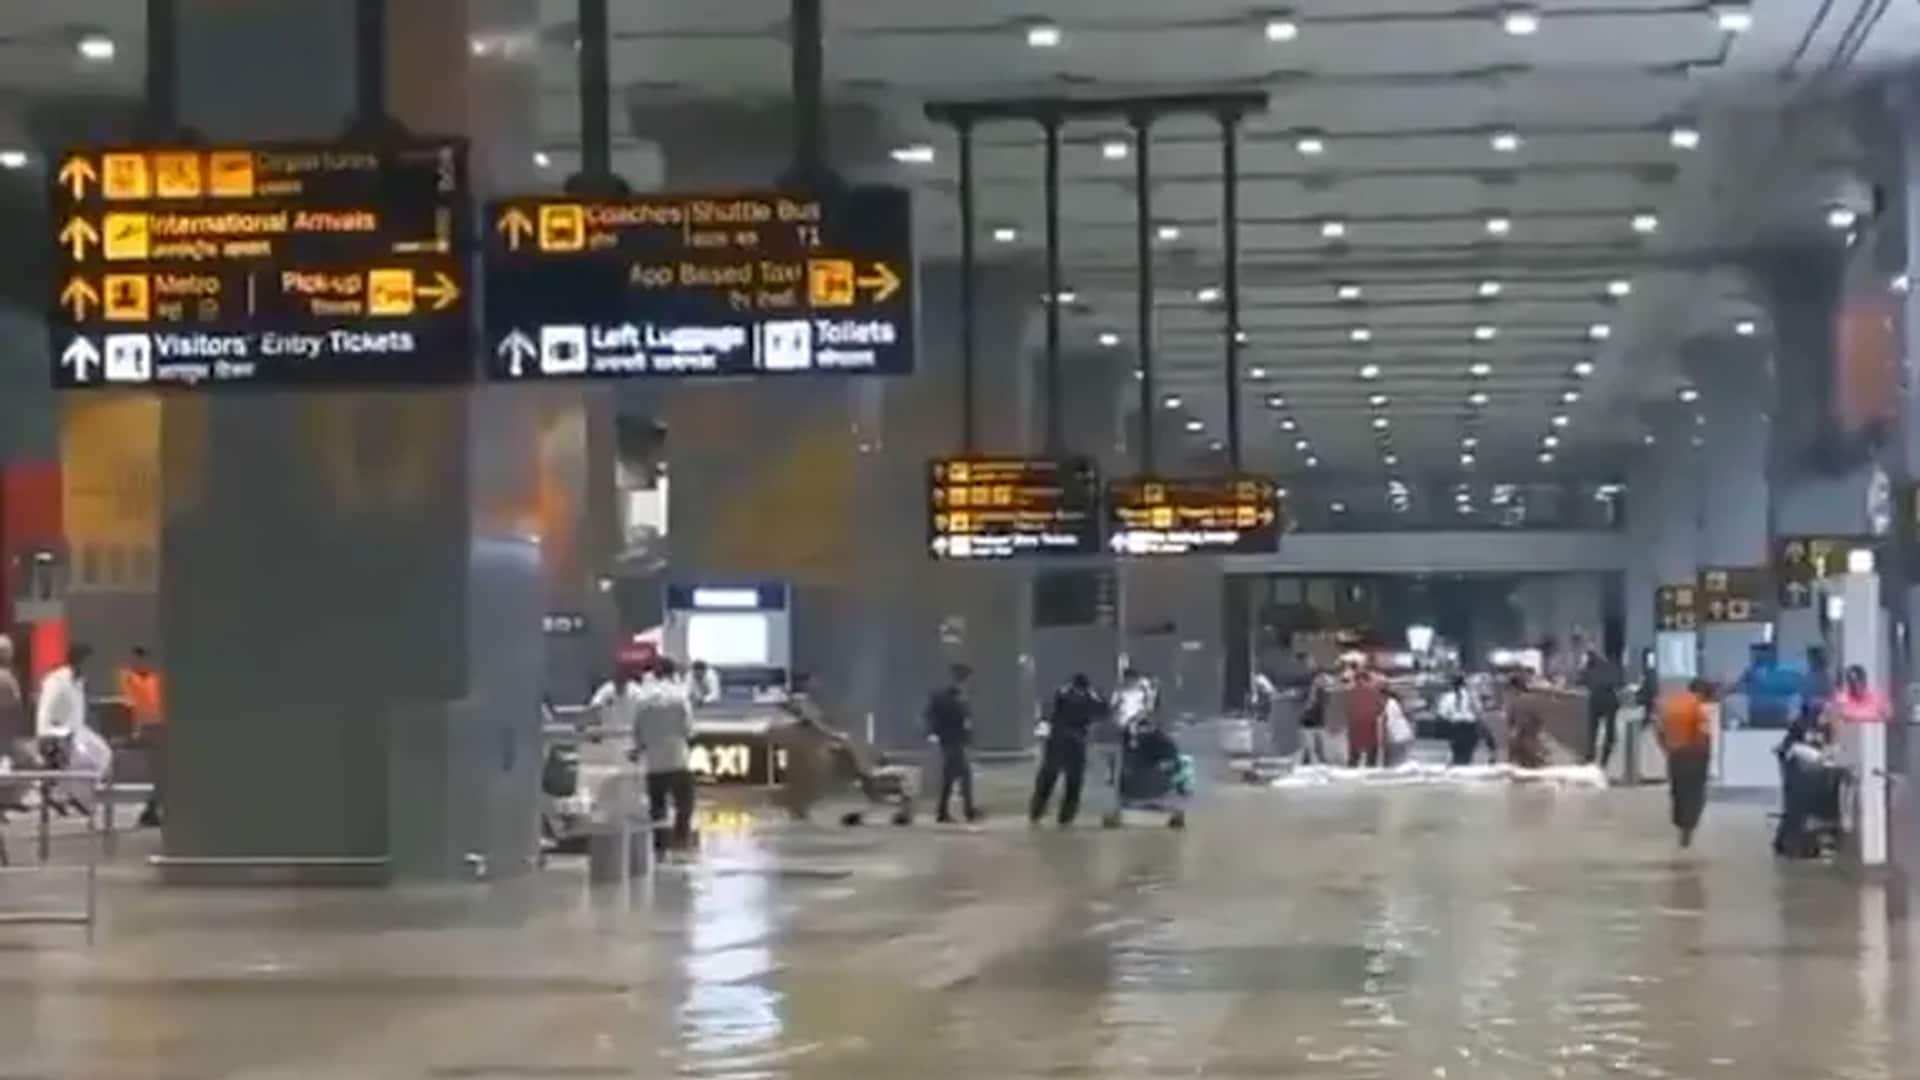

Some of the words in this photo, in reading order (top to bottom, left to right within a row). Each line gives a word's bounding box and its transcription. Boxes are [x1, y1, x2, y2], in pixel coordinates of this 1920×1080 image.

[150, 210, 287, 233] International
[293, 211, 376, 231] Arrivals
[585, 205, 683, 224] Coaches
[692, 201, 771, 222] Shuttle
[777, 200, 821, 221] Bus
[155, 274, 221, 295] Metro
[629, 261, 674, 287] App
[679, 260, 753, 284] Based
[758, 260, 803, 282] Taxi
[261, 331, 325, 358] Entry
[328, 328, 415, 353] Tickets
[591, 323, 641, 350] Left
[813, 319, 896, 344] Toilets
[688, 745, 750, 776] AXI
